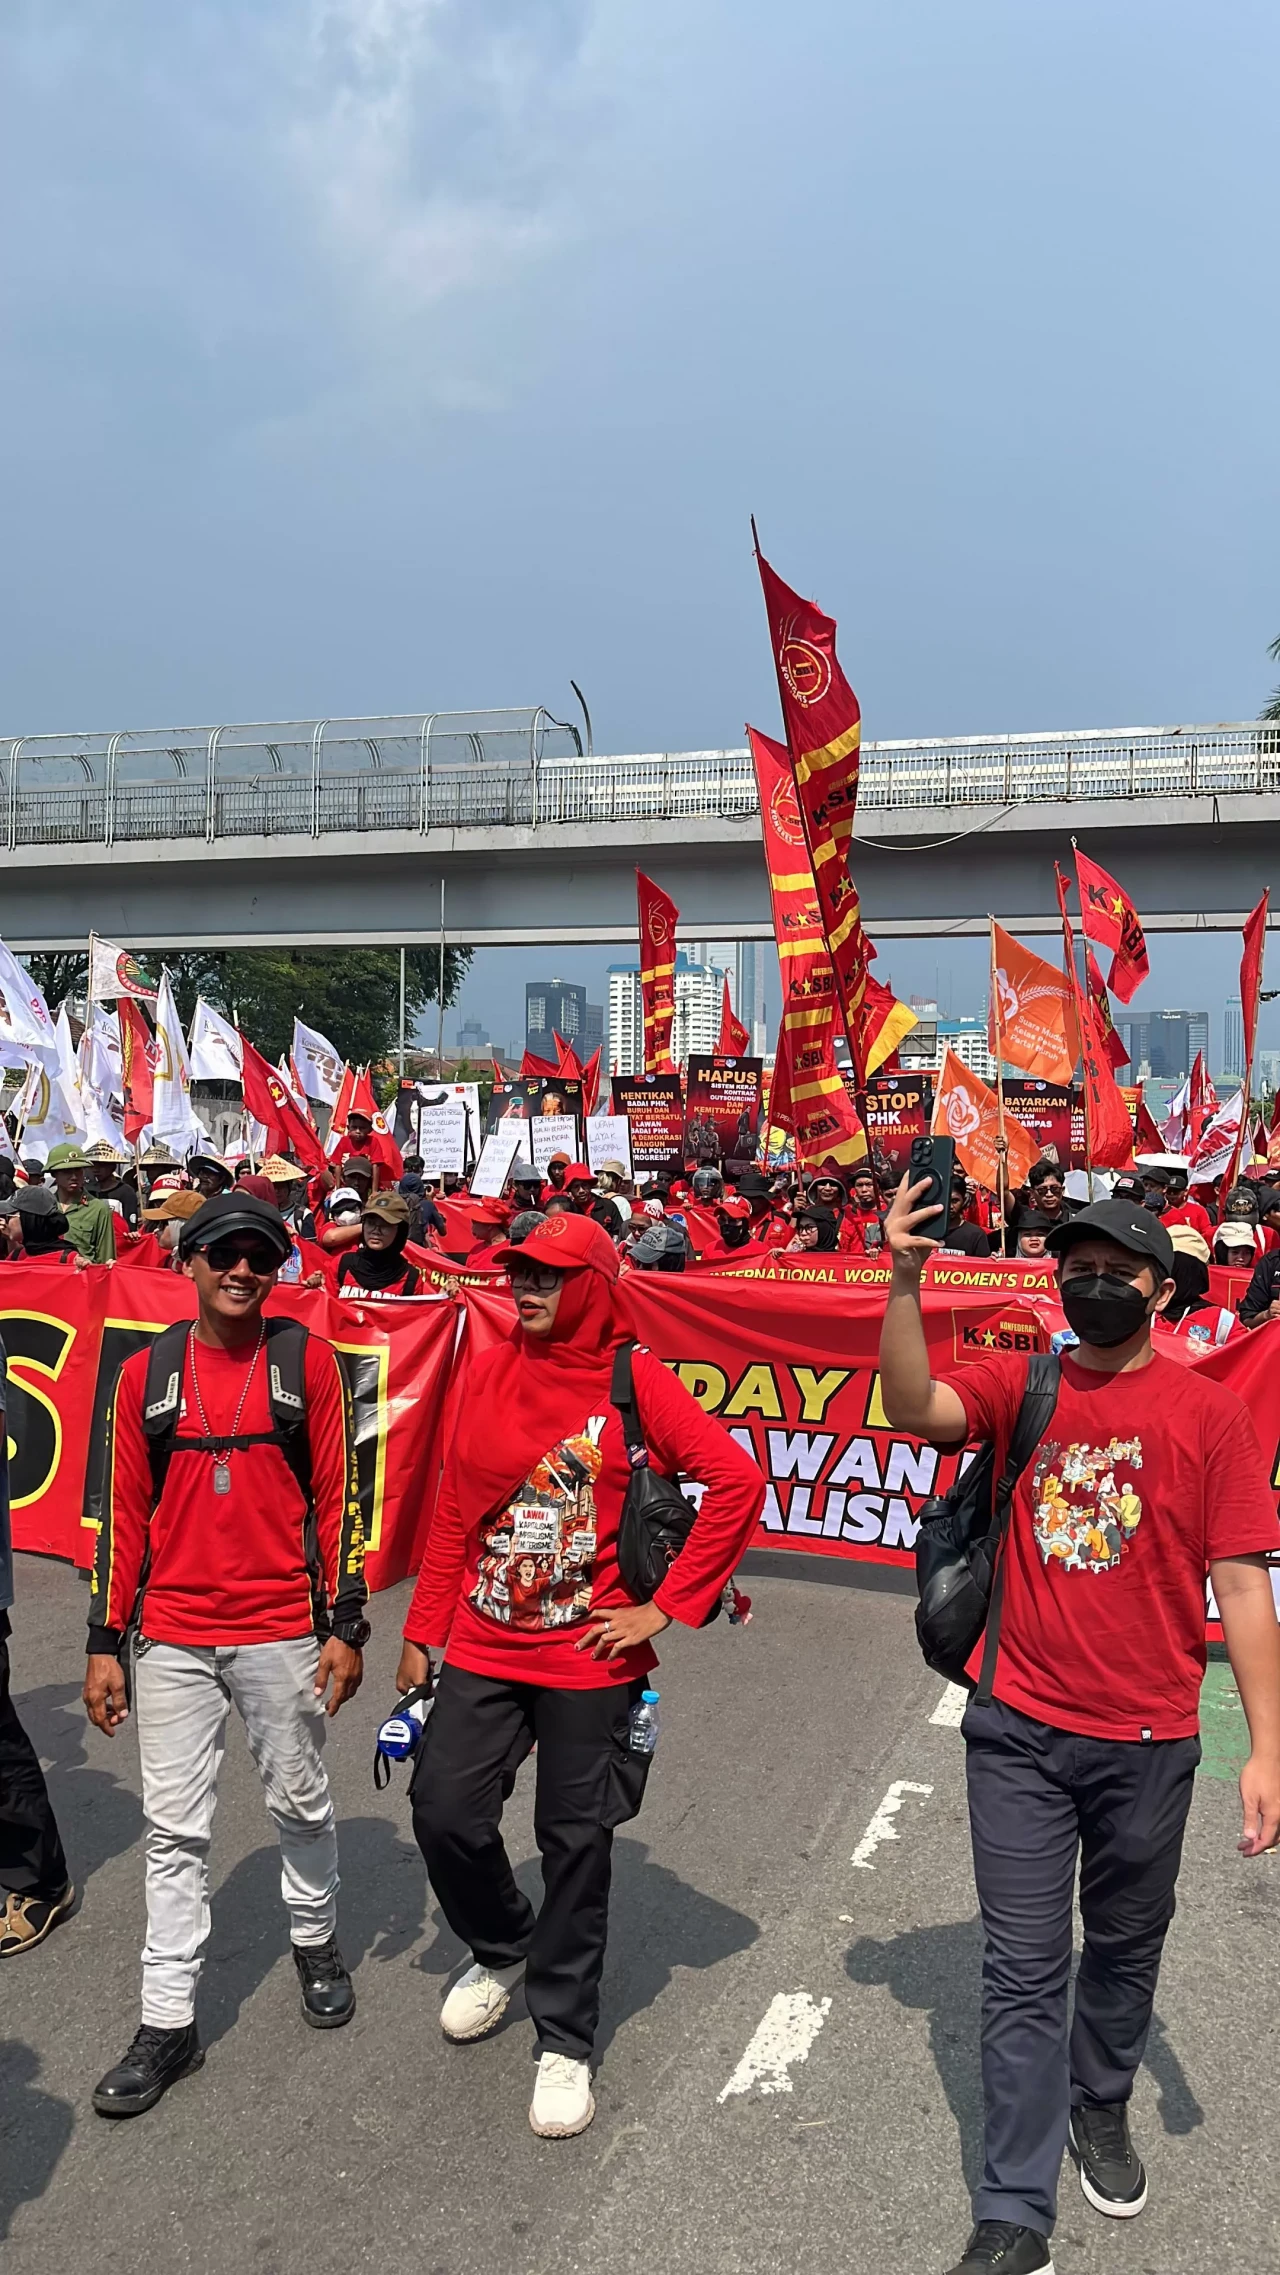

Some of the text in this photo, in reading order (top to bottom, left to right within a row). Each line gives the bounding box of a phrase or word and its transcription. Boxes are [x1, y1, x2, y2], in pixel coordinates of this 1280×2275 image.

[1018, 1016, 1064, 1043] Suara Muda
[1010, 1034, 1059, 1060] Partai Buruh
[1013, 1025, 1067, 1055] Kelas Pekerja
[698, 1069, 757, 1084] HAPUS
[620, 1092, 674, 1100] HENTIKAN
[865, 1092, 920, 1111] STOP
[1004, 1097, 1067, 1107] BAYARKAN
[694, 1106, 743, 1115] KEMITRAAN
[866, 1111, 901, 1126] PHK
[1021, 1120, 1053, 1128] AMPAS
[589, 1133, 617, 1142] LAYAK
[868, 1124, 920, 1136] SEPIHAK
[162, 1177, 181, 1189] KSN
[643, 1202, 660, 1218] KSN
[934, 1270, 1018, 1288] WOMEN'S
[1000, 1321, 1038, 1334] KONFEDERASI
[664, 1362, 850, 1421] DAY
